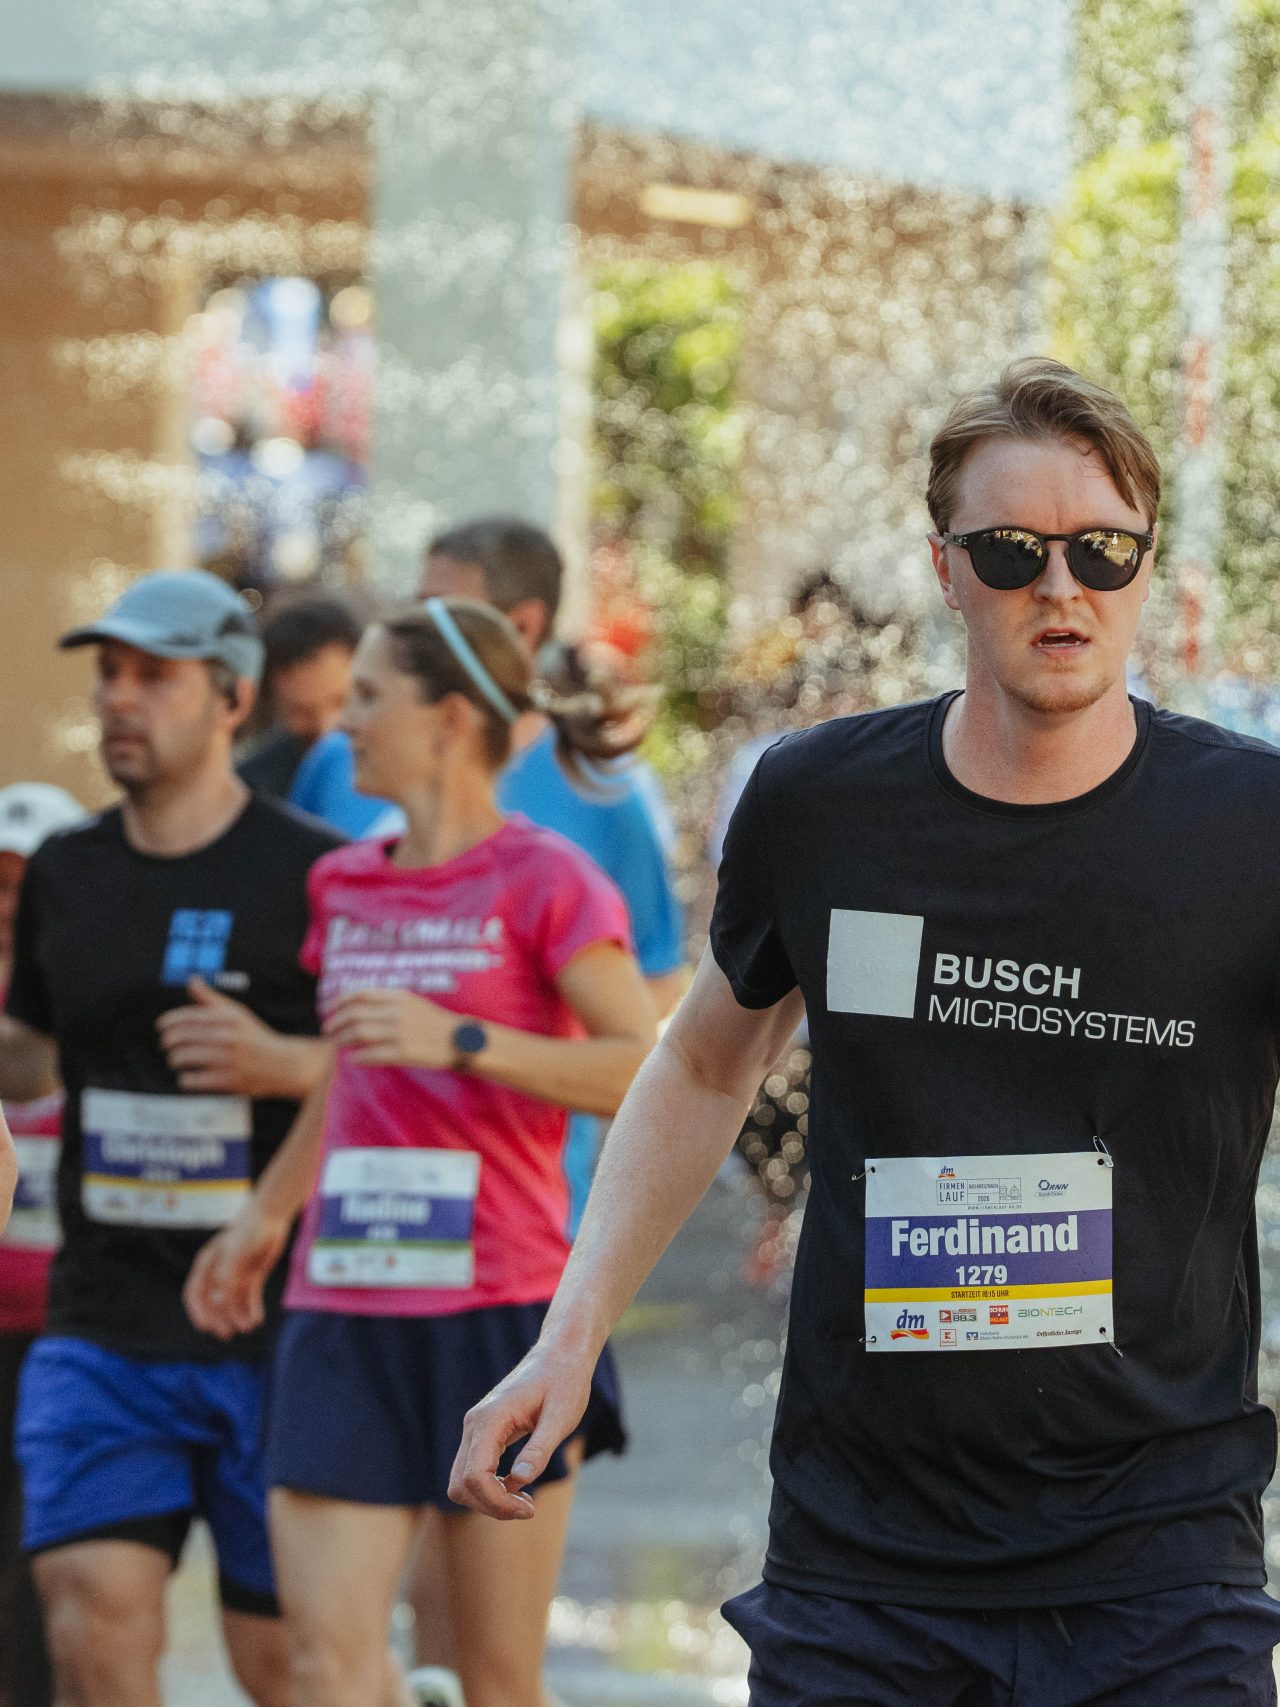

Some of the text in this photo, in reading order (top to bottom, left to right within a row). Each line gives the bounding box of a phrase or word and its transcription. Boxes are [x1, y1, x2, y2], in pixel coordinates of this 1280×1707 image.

[933, 952, 1081, 999] BUSCH
[928, 994, 1196, 1047] MICROSYSTEMS
[940, 1166, 954, 1174] dm
[939, 1182, 965, 1190] FIRMEN
[939, 1191, 965, 1202] LAUF
[891, 1214, 1079, 1257] Ferdinand
[955, 1265, 1008, 1285] 1279
[951, 1290, 981, 1299] STARTZEIT
[996, 1289, 1009, 1297] UHR
[896, 1309, 925, 1329] dm
[1017, 1306, 1083, 1318] BIONTECH
